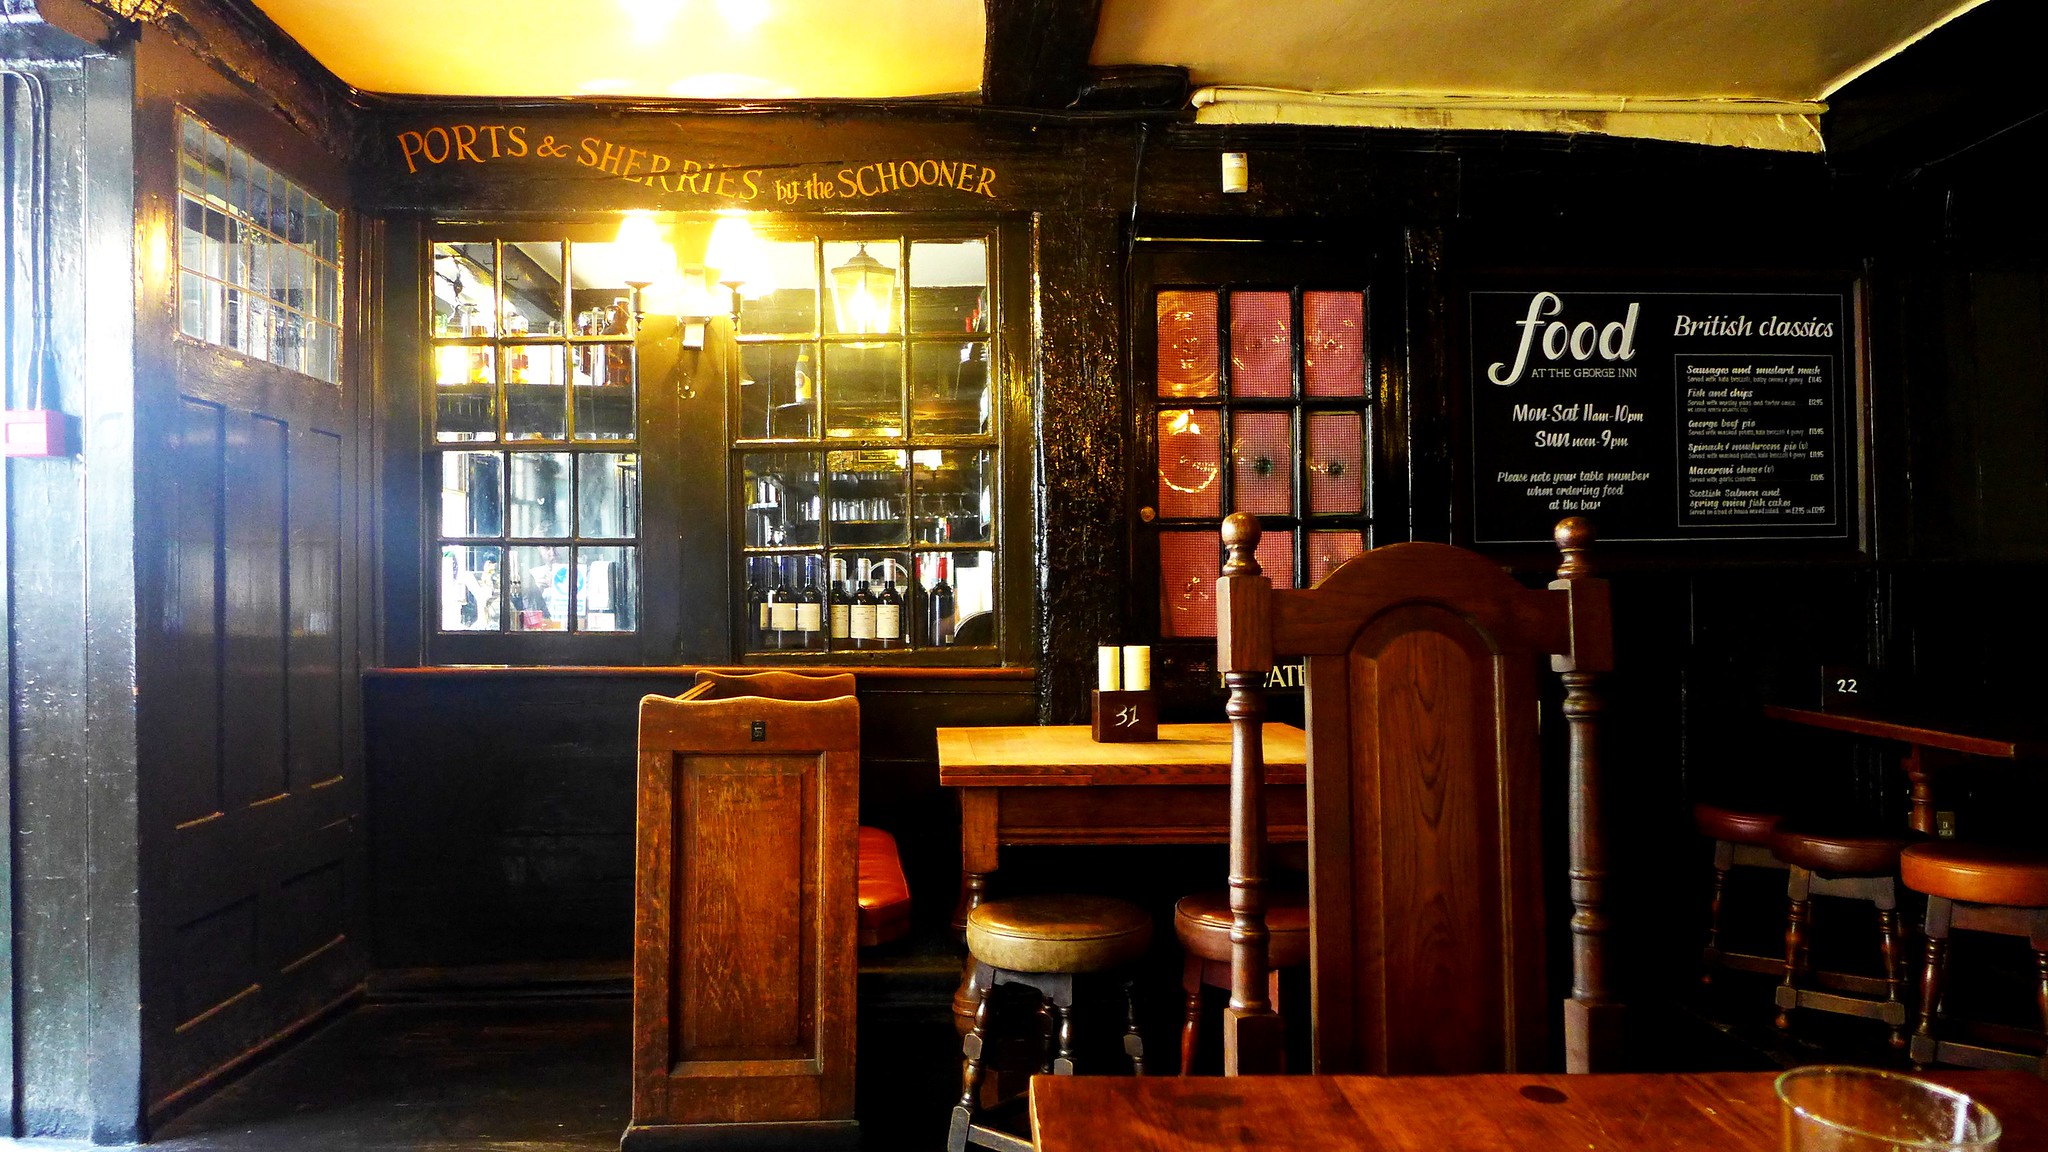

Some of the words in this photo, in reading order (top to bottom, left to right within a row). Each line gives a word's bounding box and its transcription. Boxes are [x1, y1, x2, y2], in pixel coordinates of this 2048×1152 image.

[397, 123, 528, 174] PORTS
[536, 135, 572, 158] &
[576, 136, 763, 201] SHERRIES
[775, 179, 802, 204] by
[804, 173, 836, 200] the
[837, 159, 997, 198] SCHOONER
[1674, 315, 1752, 336] British
[1759, 315, 1833, 337] classics
[1488, 291, 1641, 387] food
[1531, 368, 1546, 378] AT
[1549, 368, 1571, 378] THE
[1574, 368, 1615, 378] GEORGE
[1618, 368, 1637, 378] INN
[1687, 365, 1729, 377] Sausages
[1732, 365, 1751, 374] and
[1756, 366, 1794, 374] mustard
[1798, 366, 1820, 374] mash
[1688, 389, 1705, 397] Fish
[1708, 389, 1727, 397] and
[1730, 388, 1753, 399] chips
[1513, 404, 1579, 422] Mon-Sat
[1688, 420, 1718, 429] George
[1721, 419, 1739, 429] beef
[1742, 419, 1755, 429] pie
[1688, 443, 1724, 453] Spinach
[1732, 442, 1780, 451] mushroom
[1784, 441, 1796, 452] pie
[1689, 465, 1733, 475] Macaroni
[1736, 465, 1762, 474] cheese
[1498, 471, 1528, 482] Please
[1530, 471, 1551, 481] note
[1553, 472, 1576, 484] your
[1580, 471, 1603, 481] table
[1607, 471, 1650, 481] number
[1527, 485, 1553, 496] when
[1556, 485, 1600, 498] ordering
[1602, 485, 1624, 497] food
[1725, 489, 1758, 497] Salmon
[1762, 488, 1780, 497] and
[1549, 500, 1560, 510] at
[1563, 500, 1578, 509] the
[1581, 499, 1601, 510] bar
[1690, 499, 1718, 509] spring
[1722, 498, 1746, 507] onion
[1748, 498, 1766, 509] fish
[1768, 498, 1791, 507] cakes
[1837, 679, 1858, 694] 22
[1115, 704, 1140, 728] 31
